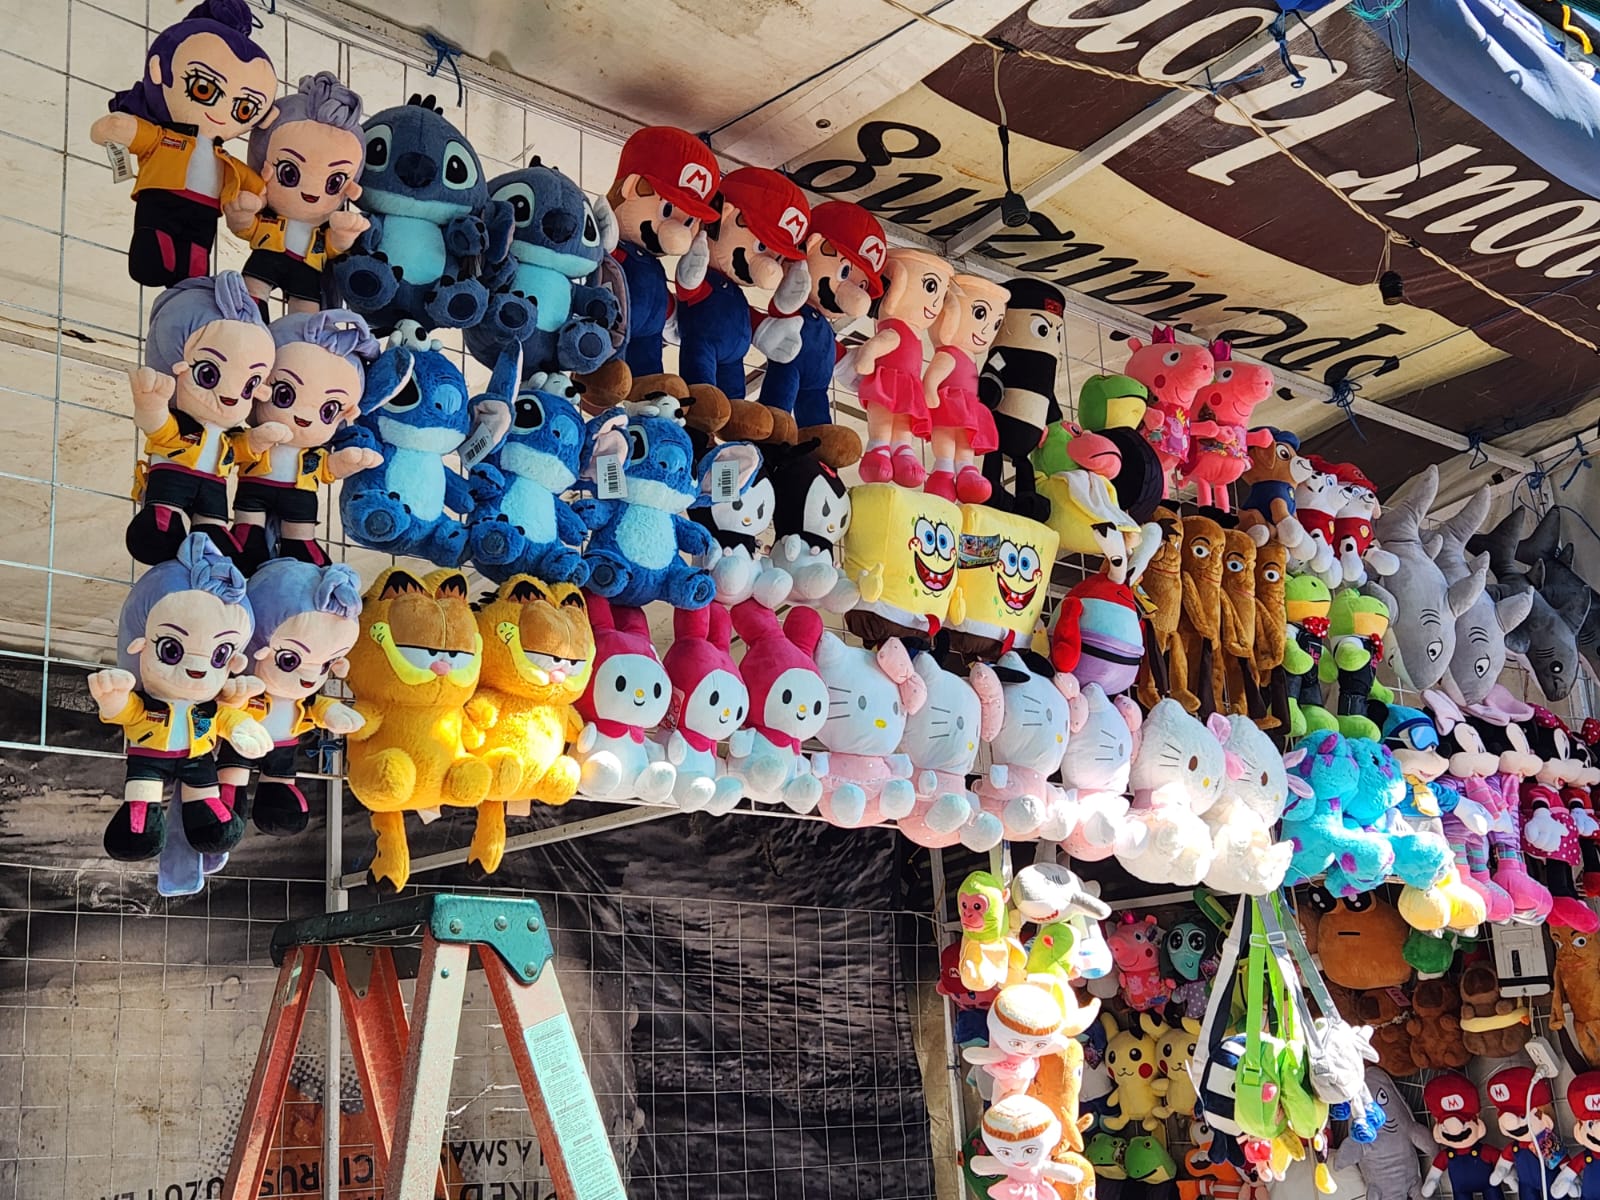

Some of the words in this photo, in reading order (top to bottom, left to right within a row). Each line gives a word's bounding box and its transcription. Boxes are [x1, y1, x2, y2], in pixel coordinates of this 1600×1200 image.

[686, 169, 707, 193] M
[785, 215, 804, 239] M
[866, 243, 883, 266] M
[440, 1140, 508, 1167] SMA
[260, 1154, 374, 1196] CIRUS
